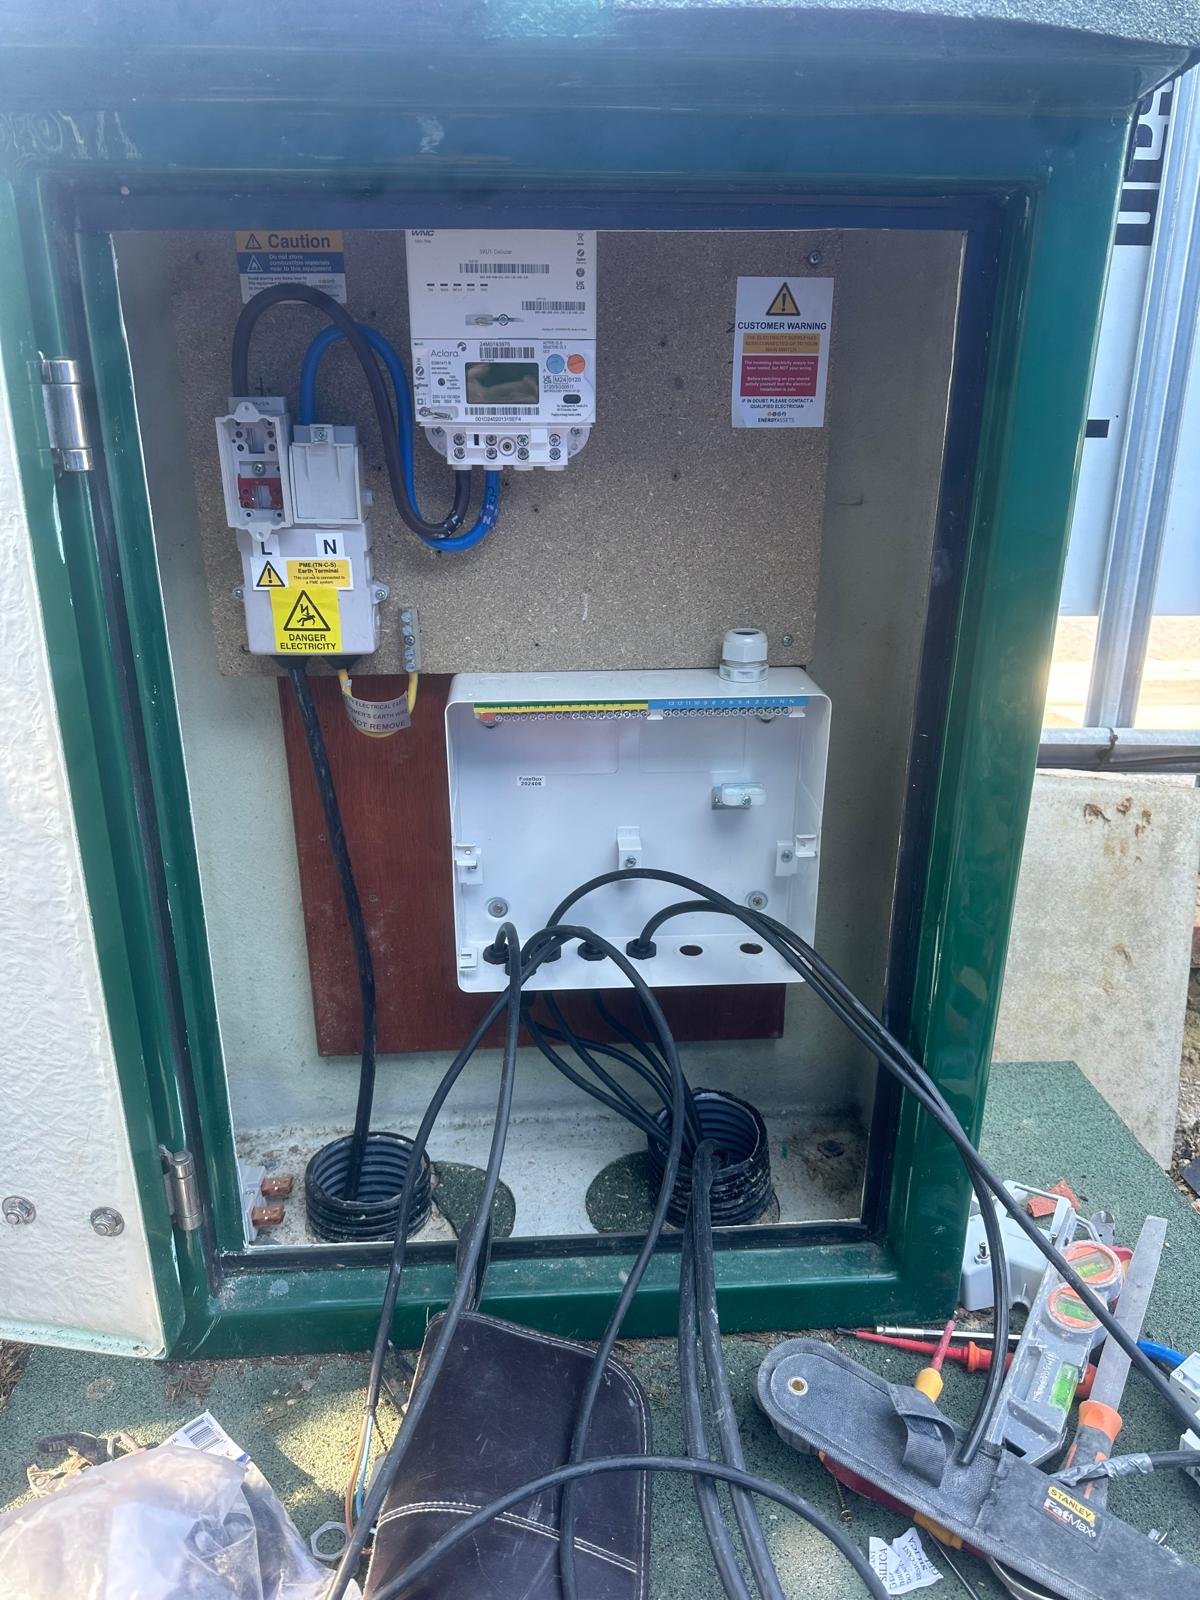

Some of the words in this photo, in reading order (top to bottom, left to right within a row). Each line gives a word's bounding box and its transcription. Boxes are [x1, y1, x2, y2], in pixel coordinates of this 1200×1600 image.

[268, 233, 331, 249] Caution
[737, 322, 785, 330] CUSTOMER
[787, 322, 827, 330] WARNING
[431, 349, 459, 358] Aclara
[261, 541, 273, 555] L
[323, 539, 337, 555] N
[288, 633, 327, 642] DANGER
[280, 642, 337, 650] ELECTRICITY
[354, 701, 391, 710] ELECTRICAL
[351, 715, 368, 728] NOT
[369, 719, 406, 730] REMOVE
[1051, 1489, 1092, 1518] STANLEY
[907, 1536, 929, 1571] SILICA
[878, 1547, 888, 1582] SILICA
